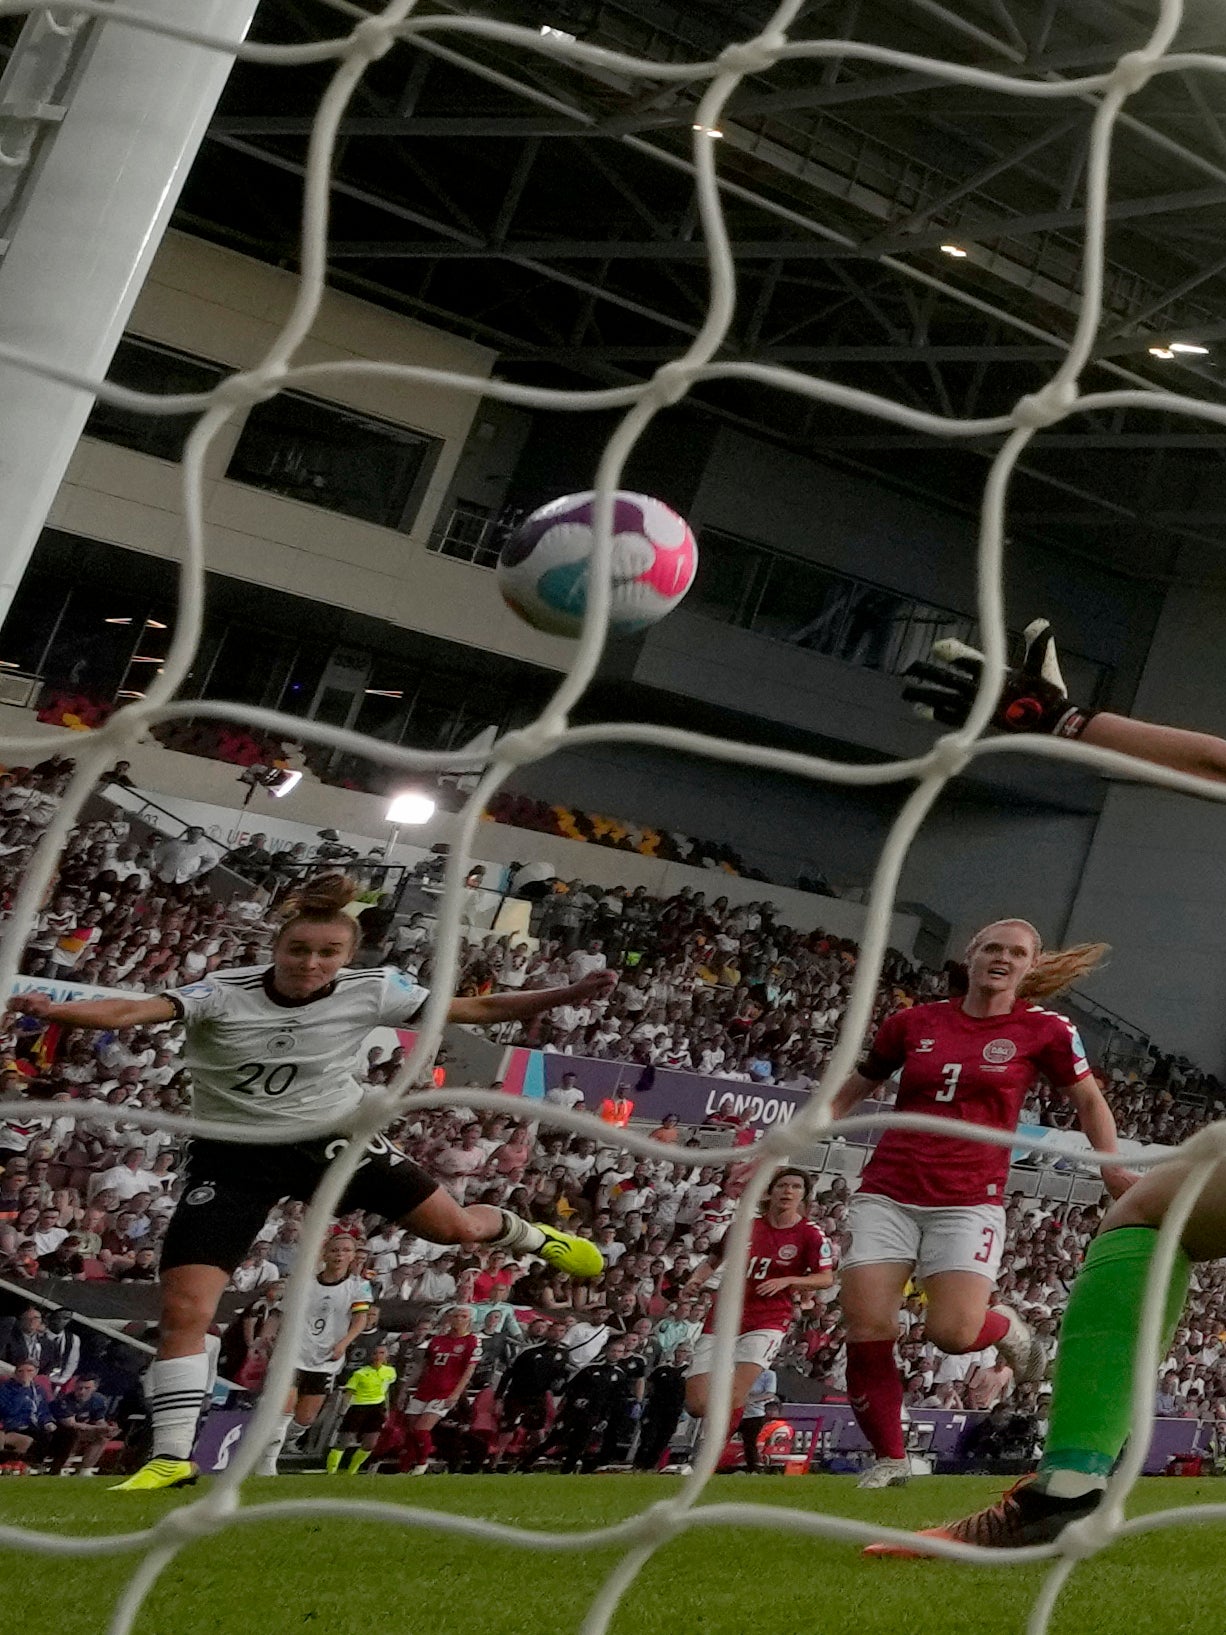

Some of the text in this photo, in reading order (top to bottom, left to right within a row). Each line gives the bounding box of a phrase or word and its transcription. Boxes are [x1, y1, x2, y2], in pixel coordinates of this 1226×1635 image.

[230, 1063, 298, 1095] 20
[935, 1063, 963, 1102] 3
[974, 1226, 995, 1263] 3
[747, 1256, 772, 1280] 13
[311, 1318, 327, 1336] 9
